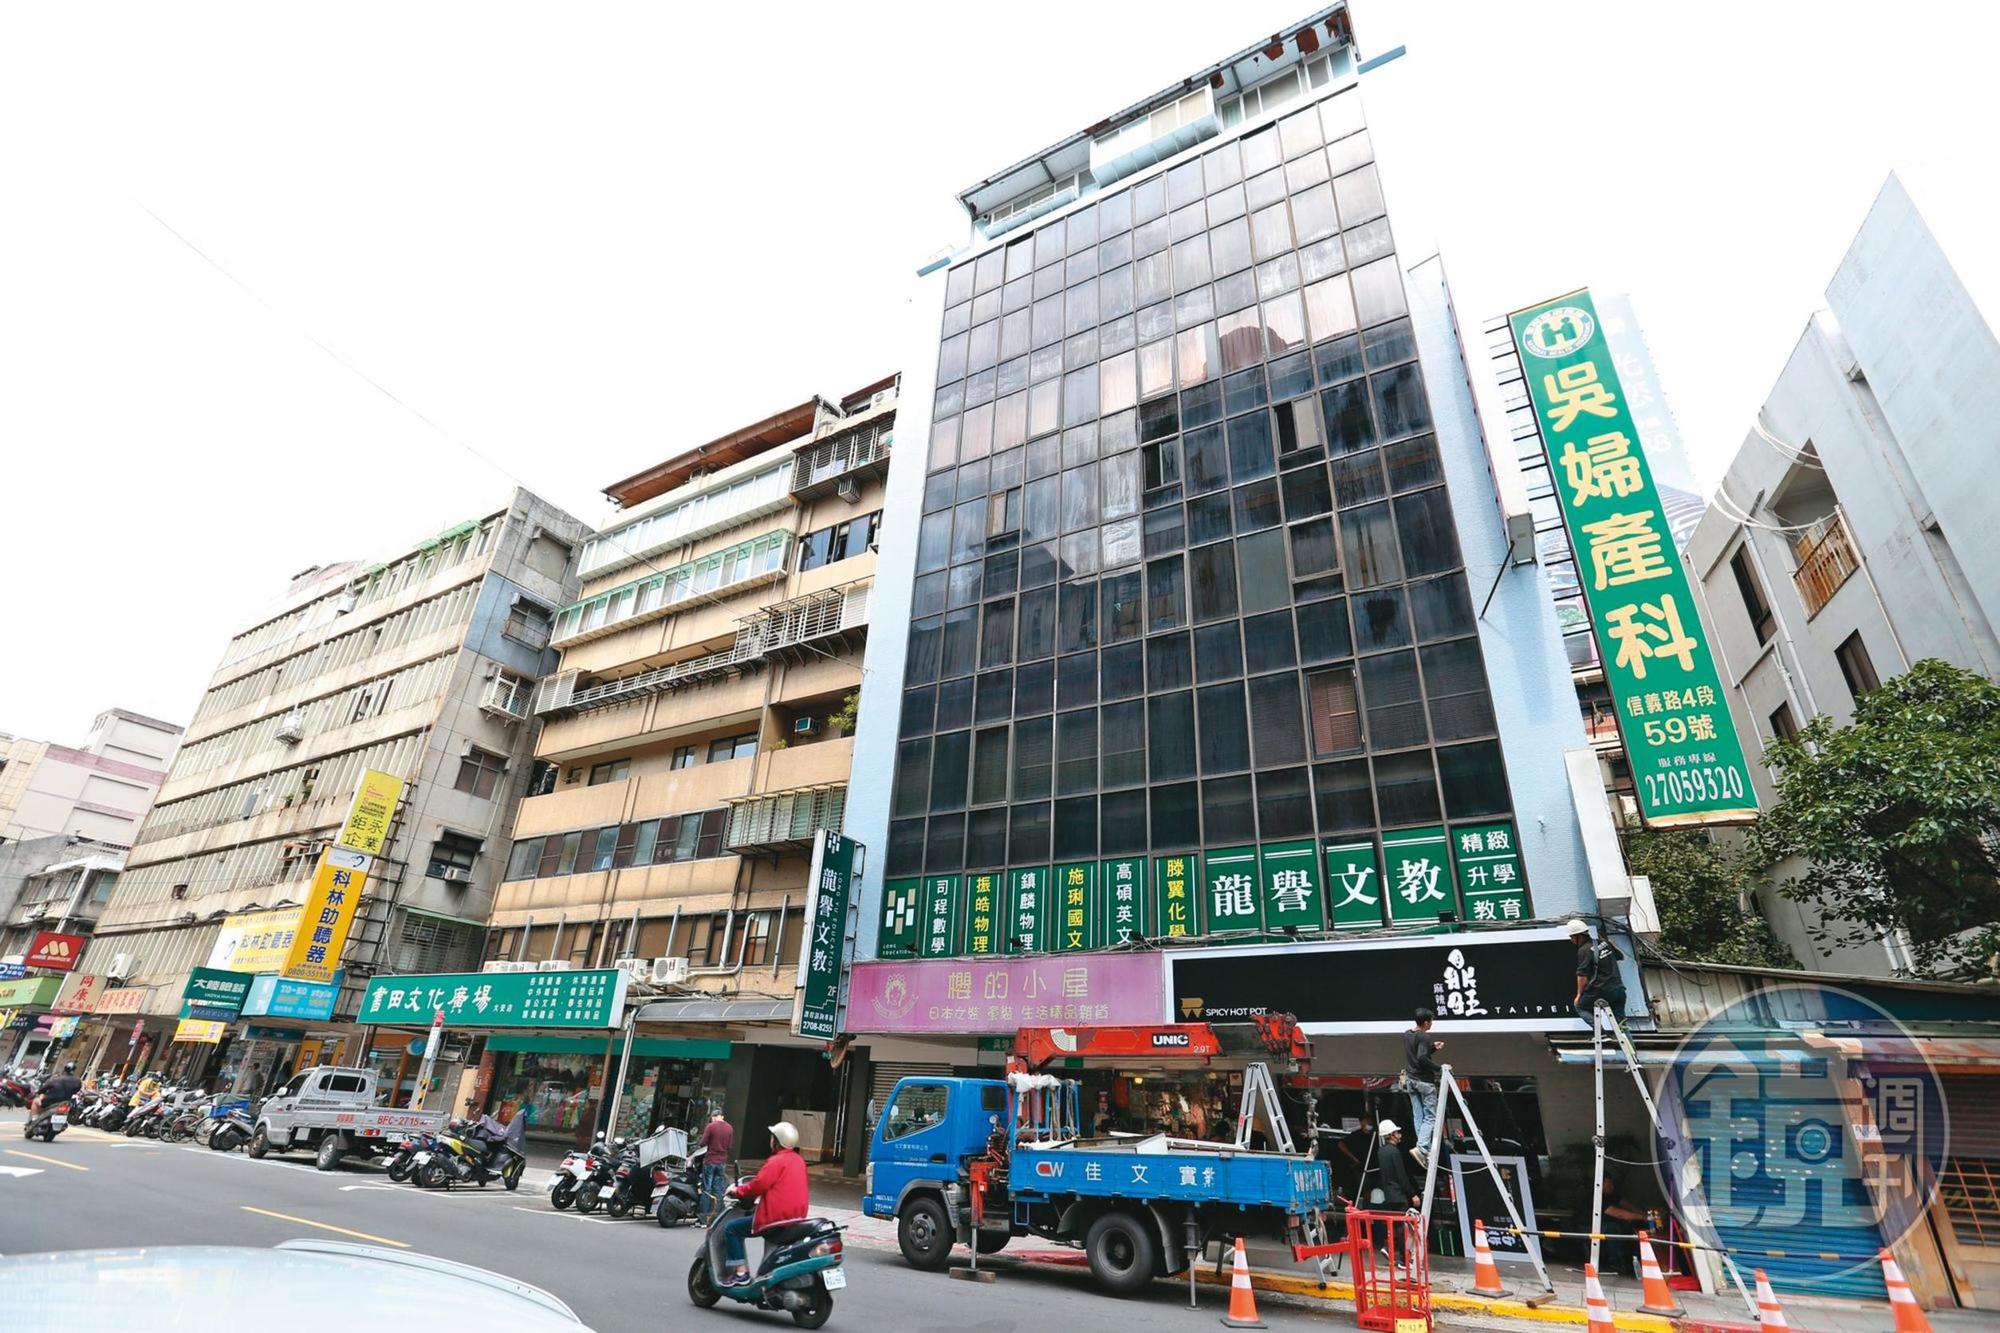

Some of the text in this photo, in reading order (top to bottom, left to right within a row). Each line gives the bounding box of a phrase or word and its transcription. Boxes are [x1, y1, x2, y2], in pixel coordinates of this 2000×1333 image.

[1543, 361, 1697, 679] 吳婦產科
[1626, 685, 1717, 717] 信義路4段
[1643, 713, 1718, 746] 59號
[1658, 752, 1717, 768] 服務專線
[1645, 765, 1744, 807] 27059320
[343, 832, 379, 851] 企業
[1461, 830, 1510, 853] 精緻
[1212, 857, 1447, 917] 龍譽文教
[1467, 863, 1516, 887] 升學
[306, 870, 351, 963] 科林助聽器
[931, 879, 949, 954] 司程數學
[1116, 862, 1134, 945] 高碩英文
[1473, 898, 1522, 920] 教育
[811, 868, 838, 973] 龍譽文教
[827, 985, 837, 997] 2F
[947, 967, 1089, 1000] 櫻的小屋
[370, 984, 492, 1014] 書田文化廣場
[1205, 1007, 1267, 1016] SPICY HOT POT
[1433, 983, 1448, 1017] 麻辣鍋
[1494, 1005, 1570, 1015] TAIPEI
[929, 1005, 980, 1021] 日本女裝
[1152, 1034, 1189, 1046] UNIC
[1193, 1045, 1210, 1054] 2.9T
[377, 1114, 420, 1126] BFC-2715
[1084, 1161, 1216, 1188] 佳文實業
